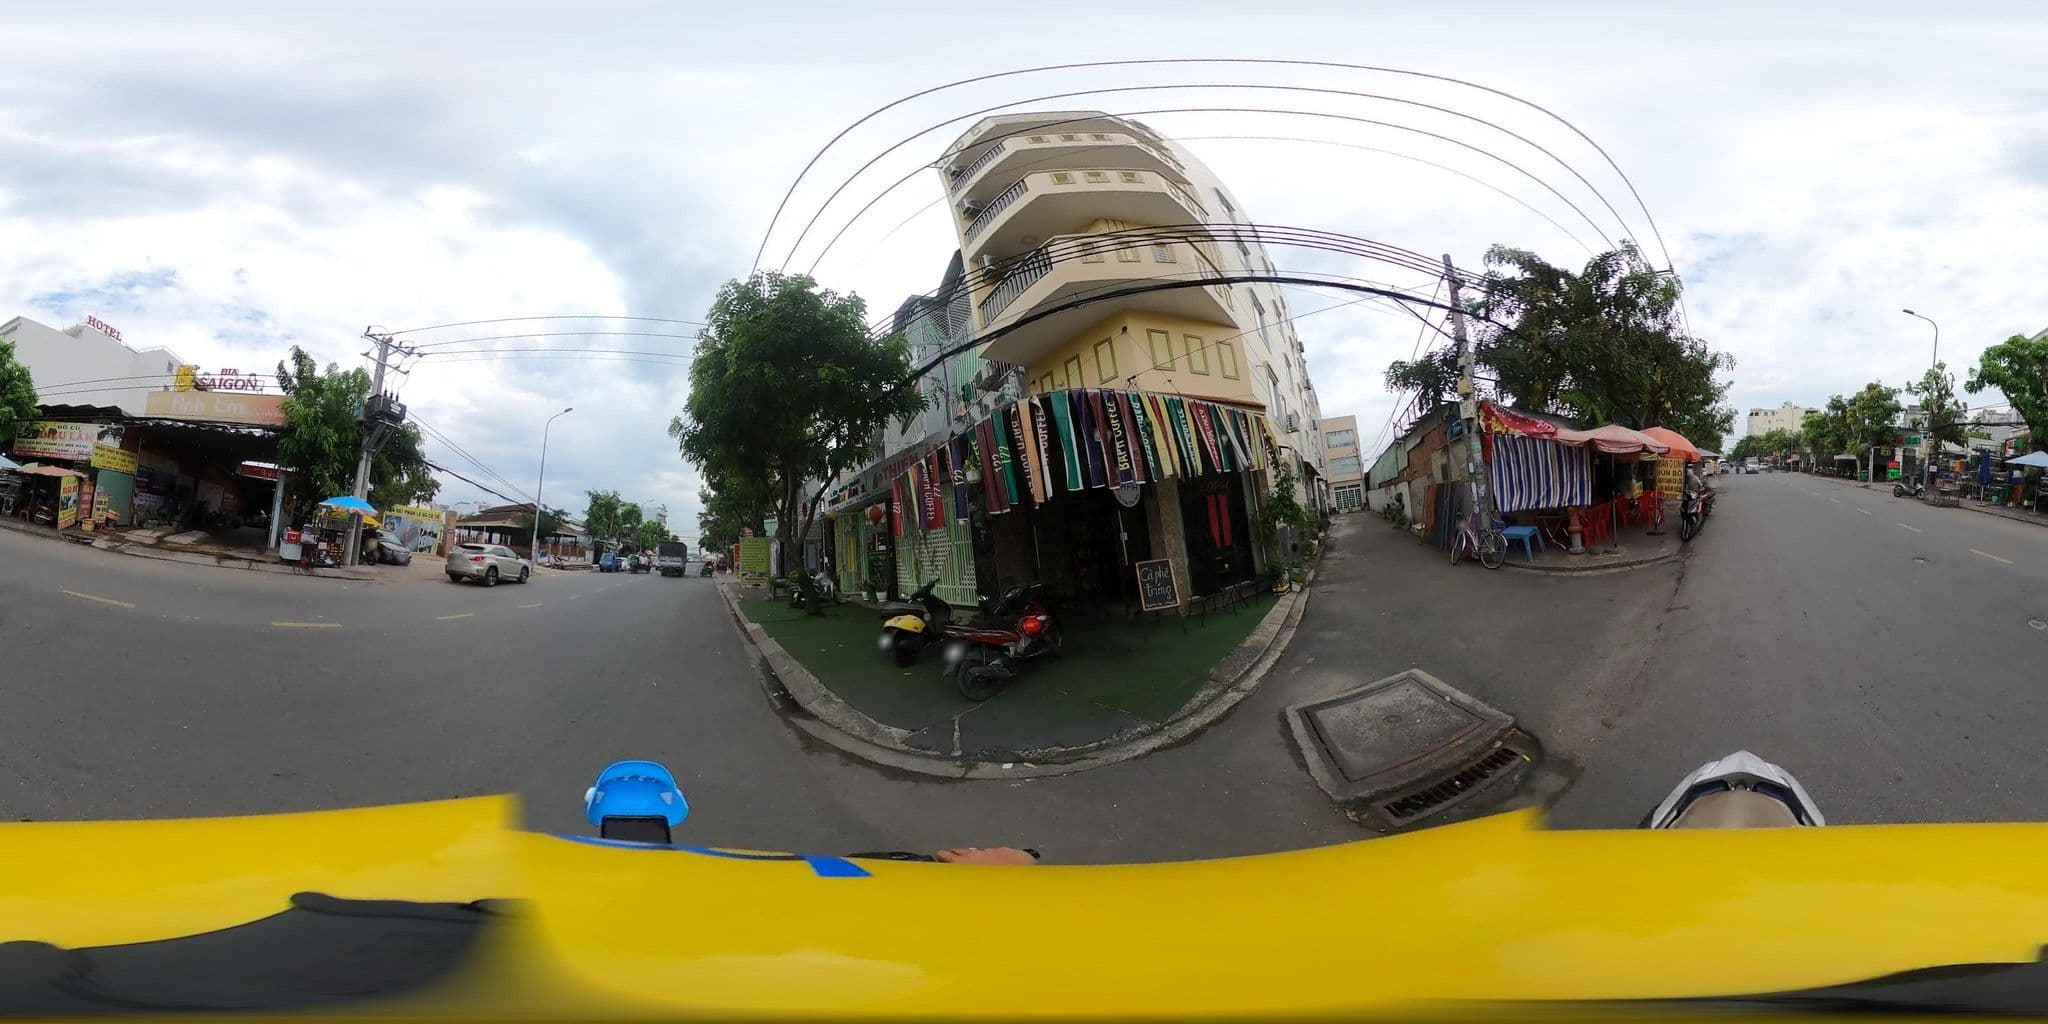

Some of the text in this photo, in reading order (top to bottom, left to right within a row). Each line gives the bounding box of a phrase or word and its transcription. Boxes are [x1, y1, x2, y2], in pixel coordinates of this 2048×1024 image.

[87, 314, 122, 342] HOTEL
[220, 368, 239, 376] BIA
[199, 377, 257, 391] SAIGON
[991, 453, 1003, 473] 122
[998, 445, 1012, 464] 122
[953, 469, 965, 485] 122
